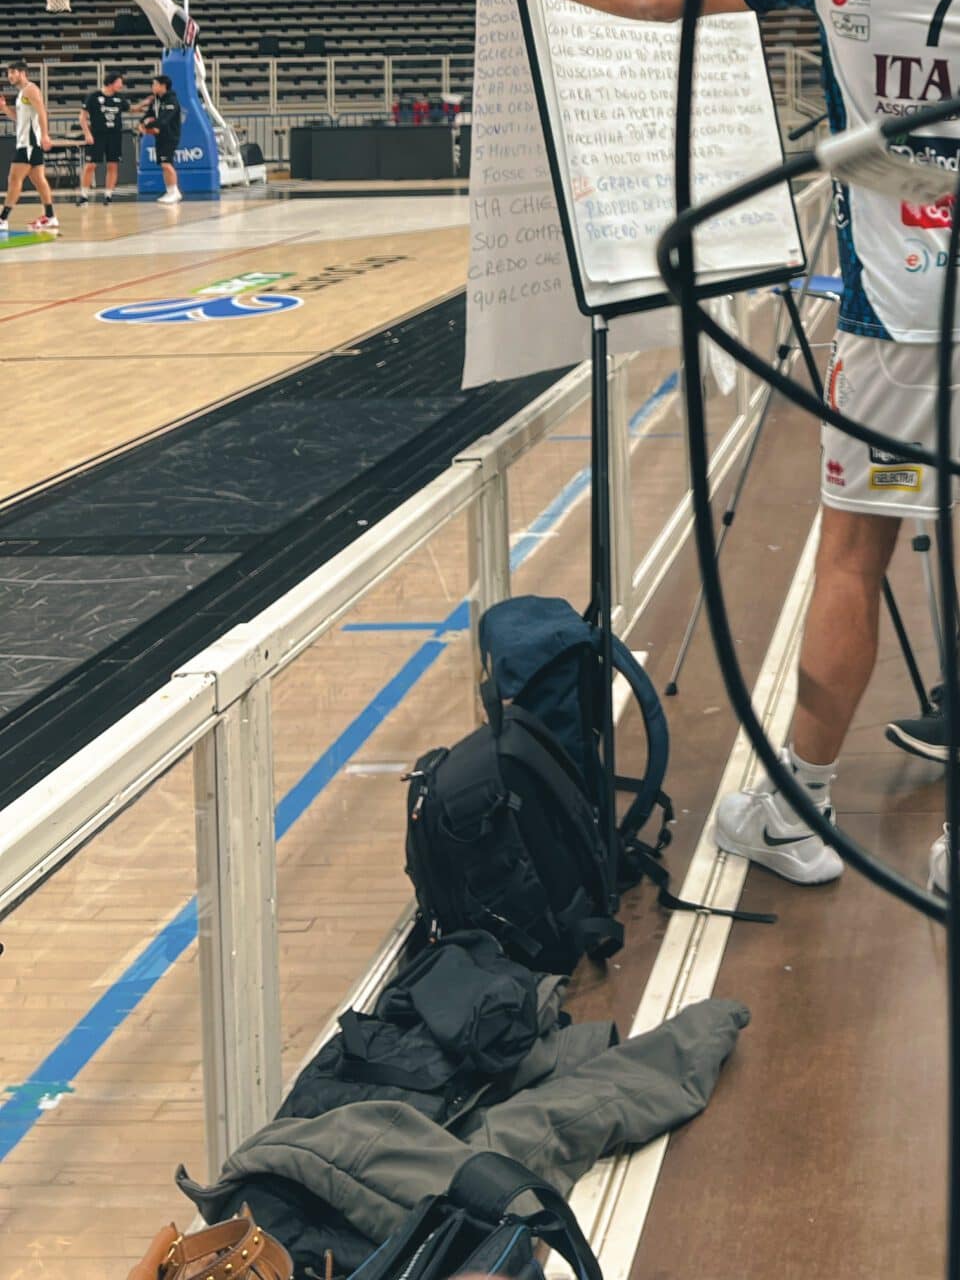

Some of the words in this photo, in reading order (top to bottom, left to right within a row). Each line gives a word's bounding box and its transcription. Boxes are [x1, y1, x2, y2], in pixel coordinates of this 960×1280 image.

[474, 198, 502, 219] MA
[471, 231, 509, 252] SUO
[467, 256, 528, 281] CREDO
[472, 277, 564, 312] QUALCOSA
